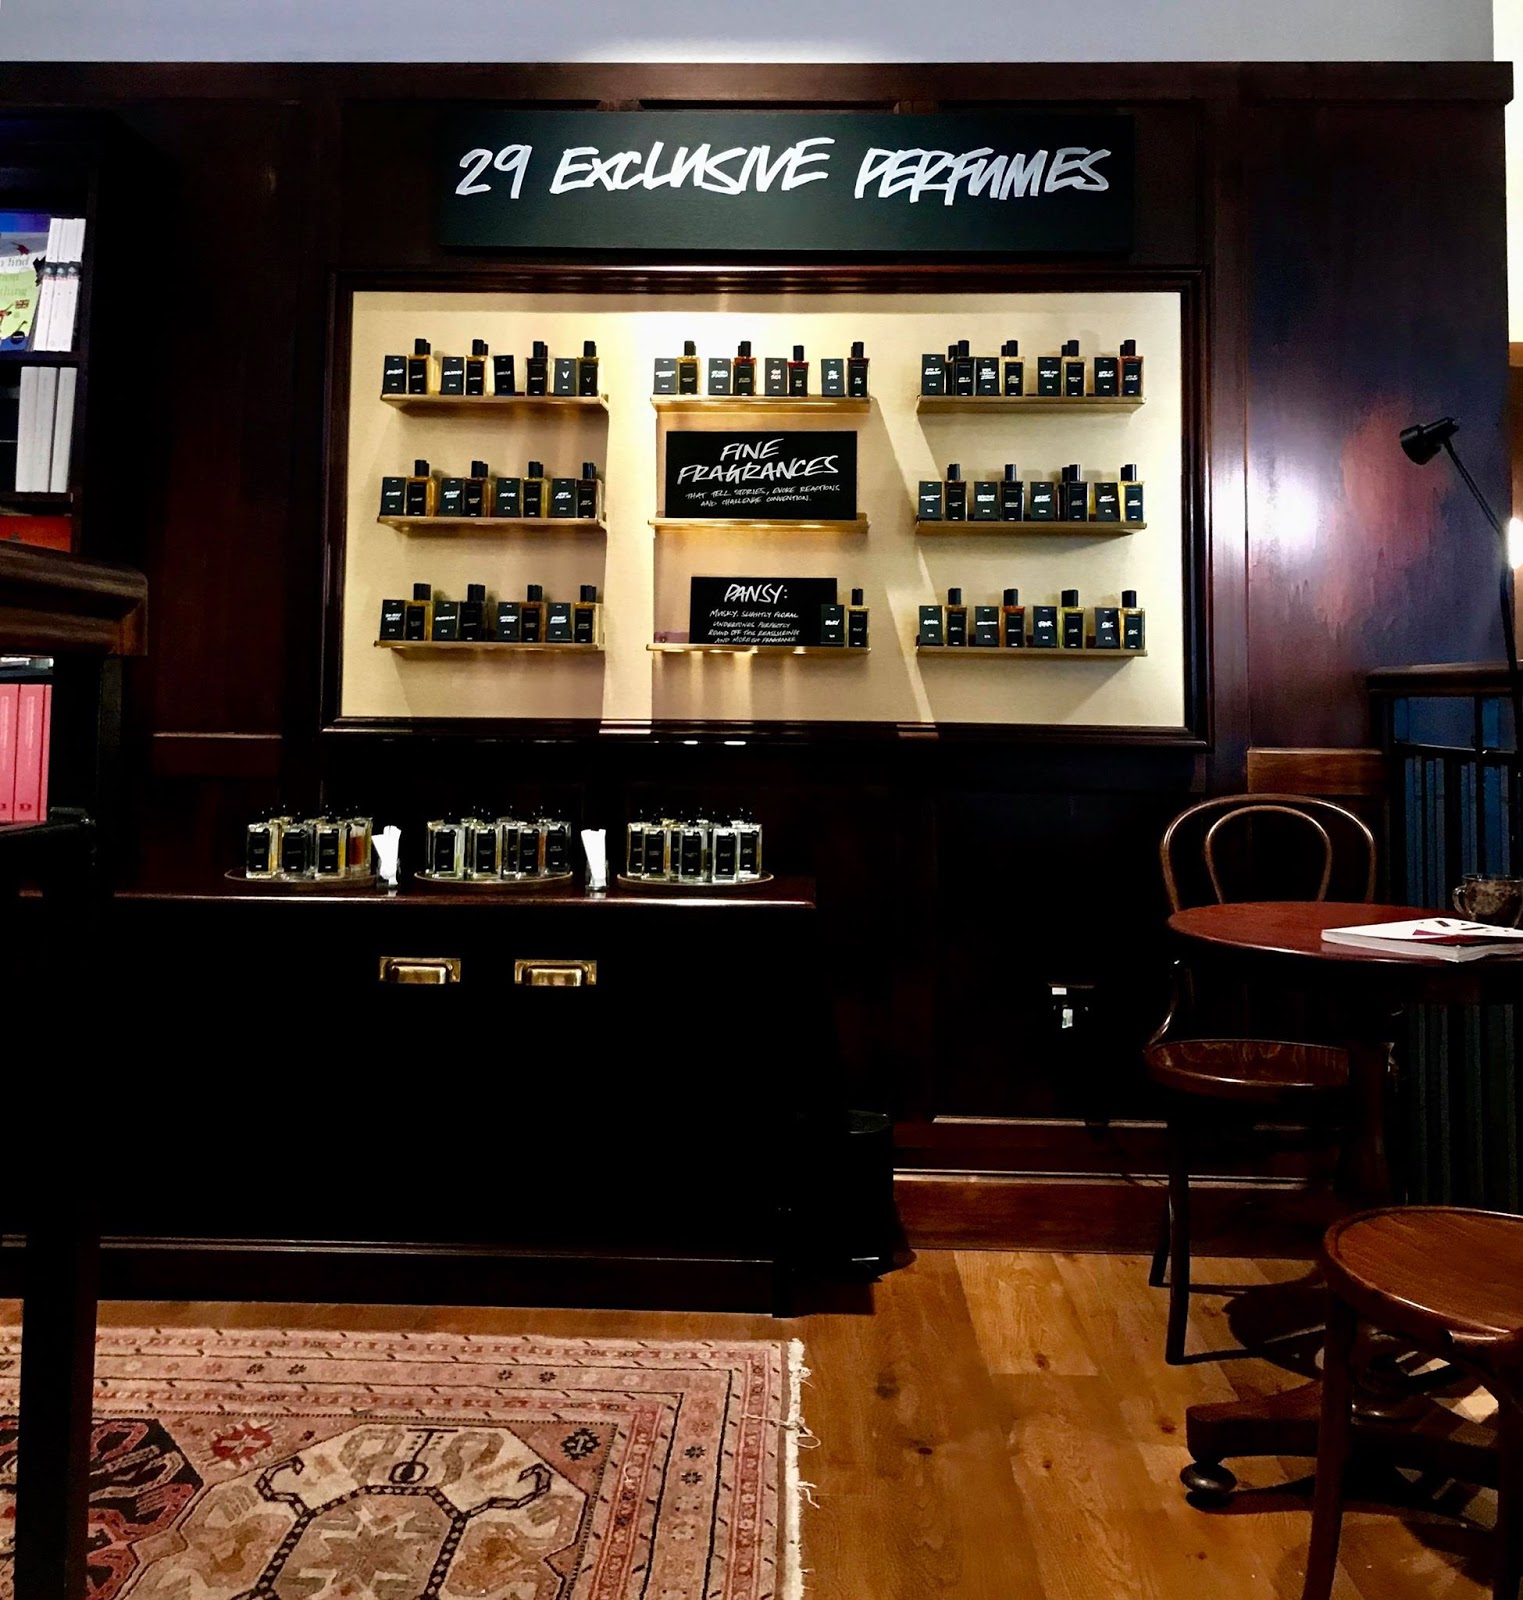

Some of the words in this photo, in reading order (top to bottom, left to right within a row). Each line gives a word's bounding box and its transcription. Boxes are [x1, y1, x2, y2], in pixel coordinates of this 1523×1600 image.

[456, 145, 532, 199] 29
[550, 137, 835, 195] EXCLUSIVE
[855, 148, 1110, 205] PERFUMES
[720, 438, 784, 461] FINE
[677, 455, 838, 484] FRAGRANCES
[685, 492, 708, 500] THAT
[711, 489, 732, 498] TELL
[772, 485, 795, 494] EVOKE
[800, 484, 840, 493] REACTIONS
[700, 500, 717, 508] AND
[721, 497, 762, 506] CHALLENGE
[741, 610, 772, 618] SLIGHTLY
